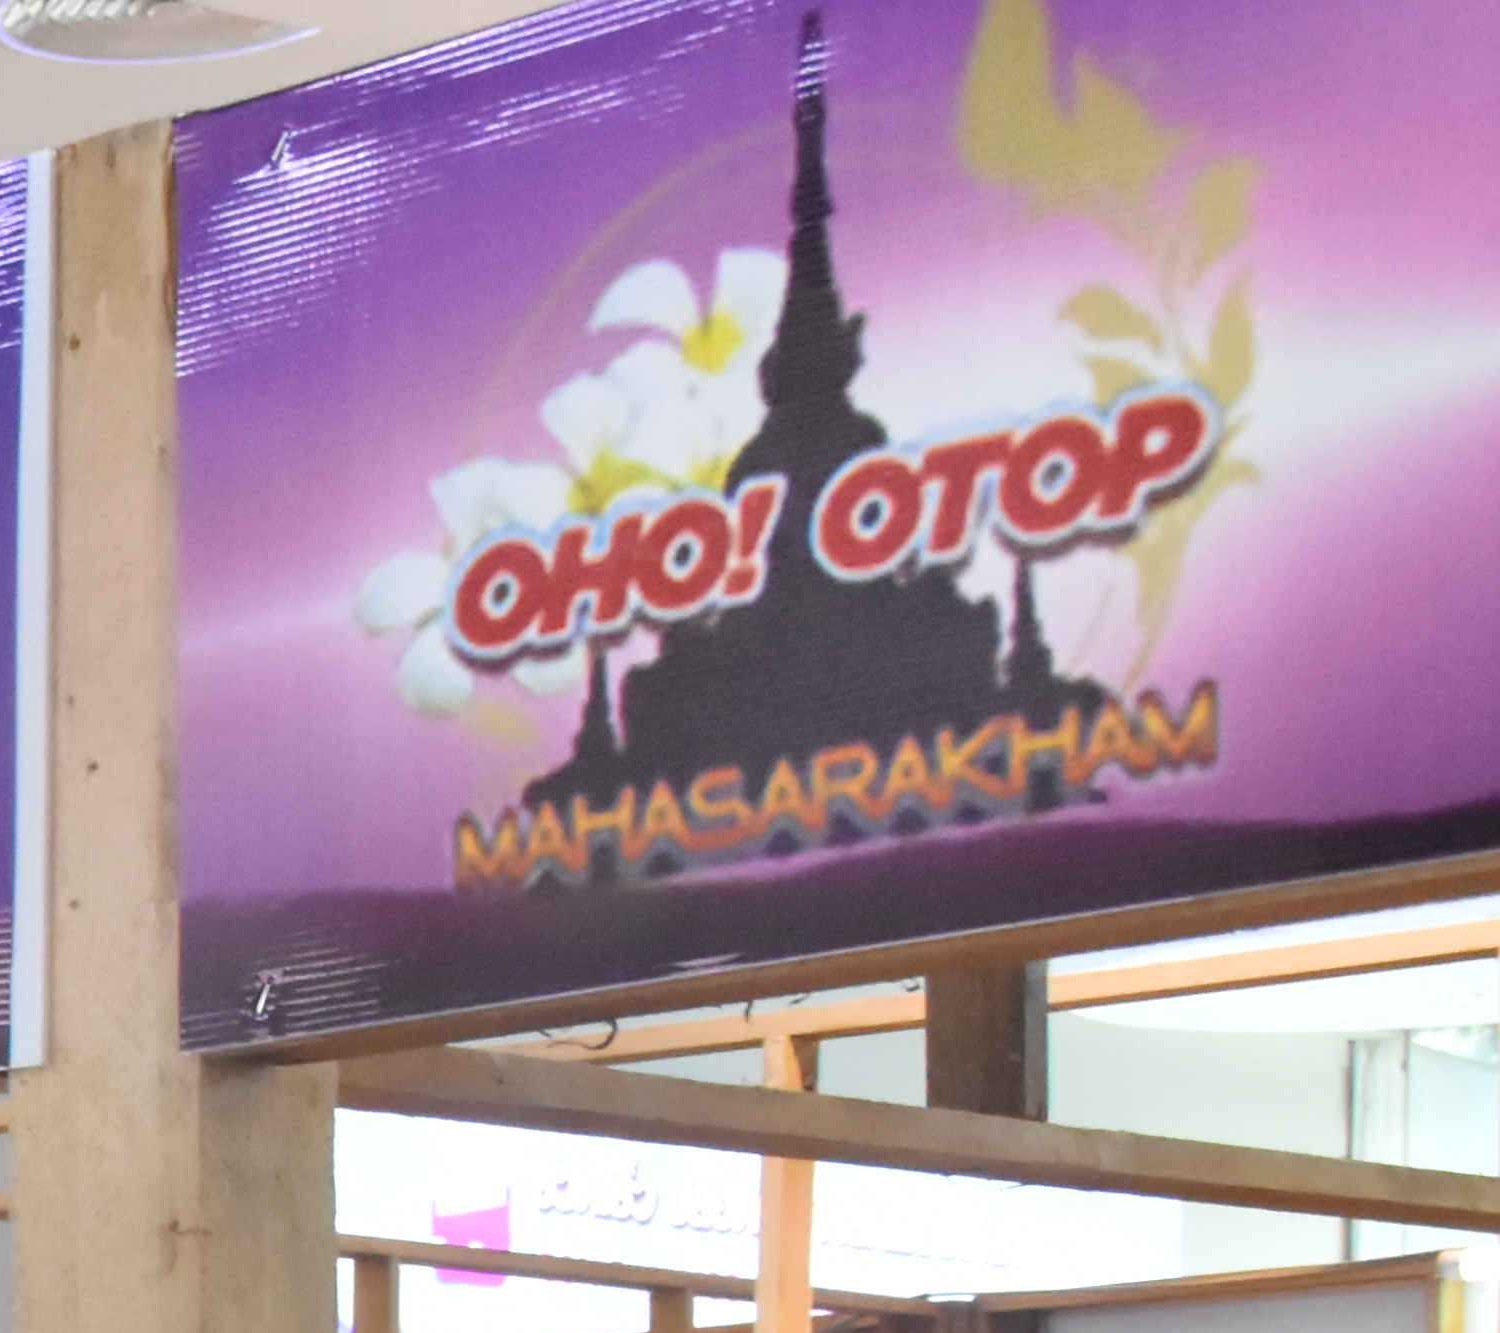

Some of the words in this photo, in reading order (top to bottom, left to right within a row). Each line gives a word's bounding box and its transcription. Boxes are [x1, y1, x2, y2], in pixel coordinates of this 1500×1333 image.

[448, 476, 786, 656] OHO!
[813, 384, 1214, 581] OTOP
[452, 678, 1220, 890] MAHASARAKHAM
